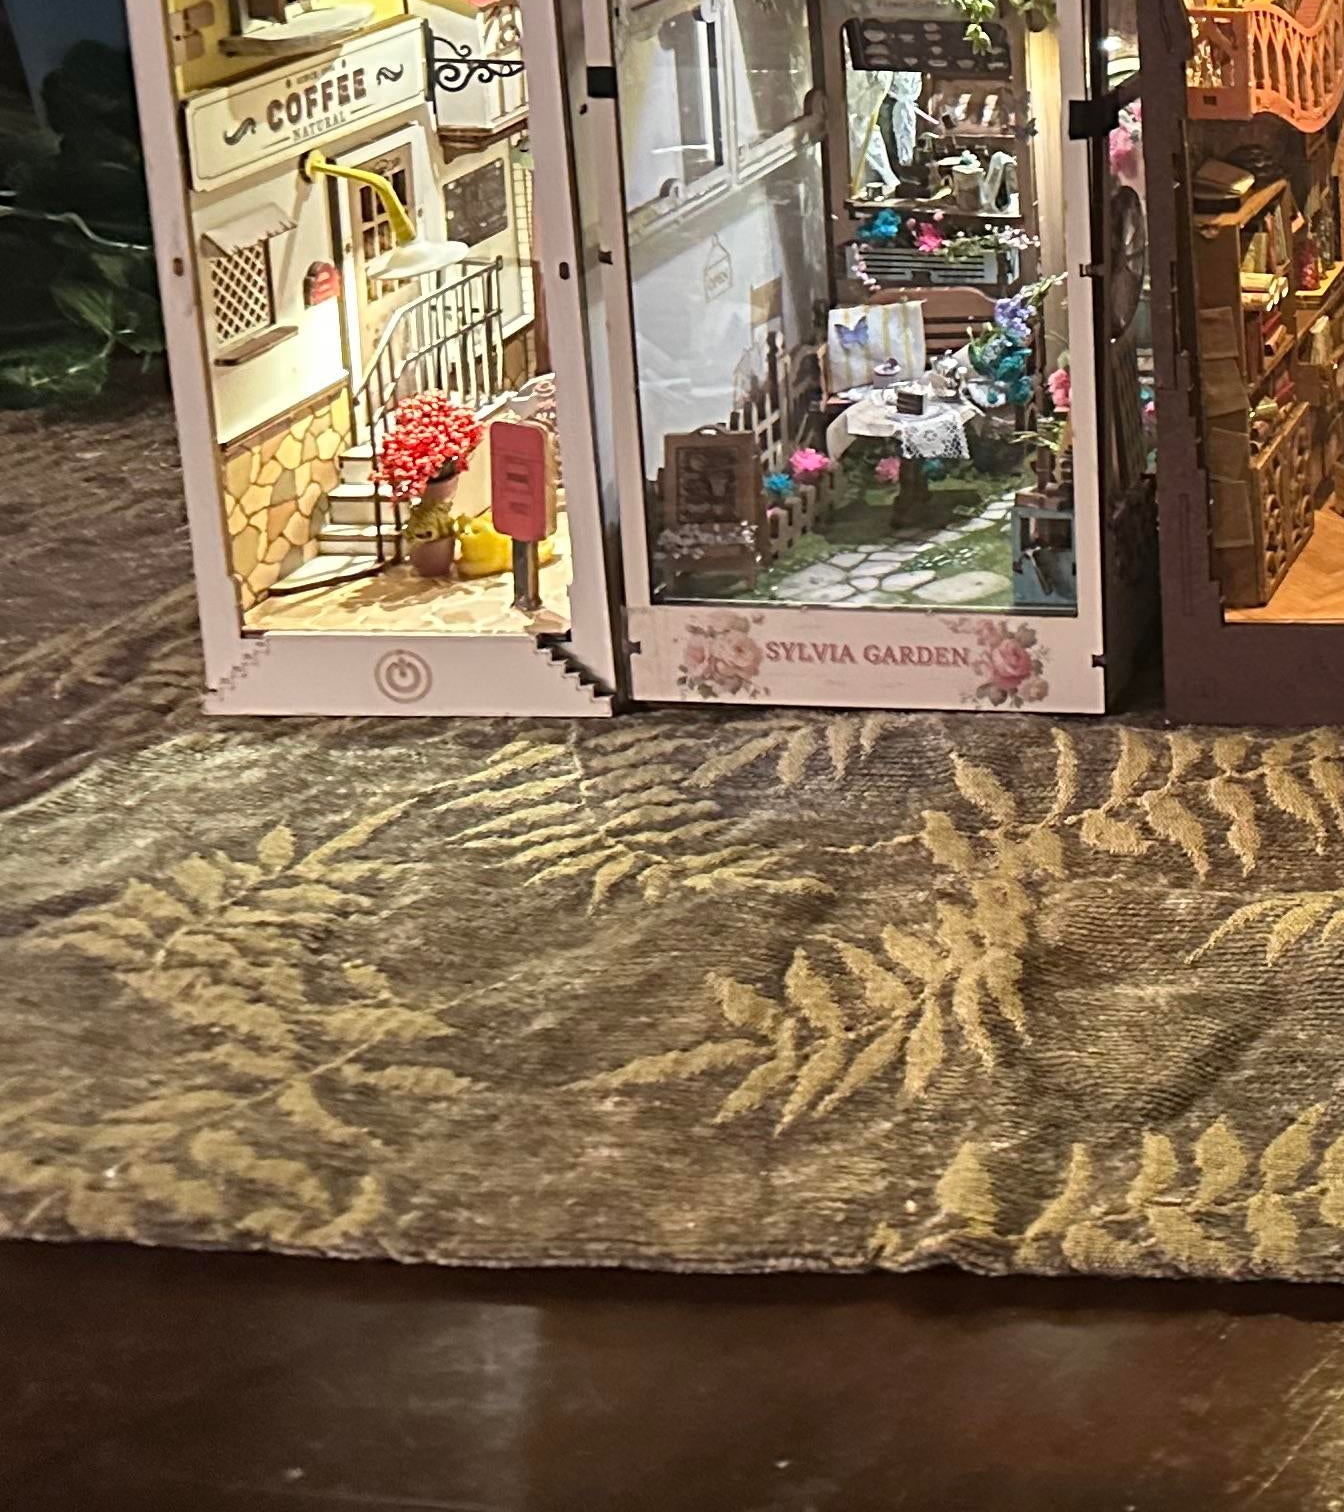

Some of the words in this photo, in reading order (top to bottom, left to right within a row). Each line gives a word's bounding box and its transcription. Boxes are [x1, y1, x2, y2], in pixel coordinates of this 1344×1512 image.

[267, 67, 367, 133] COFFEE
[292, 110, 347, 142] NATURAL
[765, 641, 859, 665] SYLVIA
[862, 644, 971, 667] GARDEN
